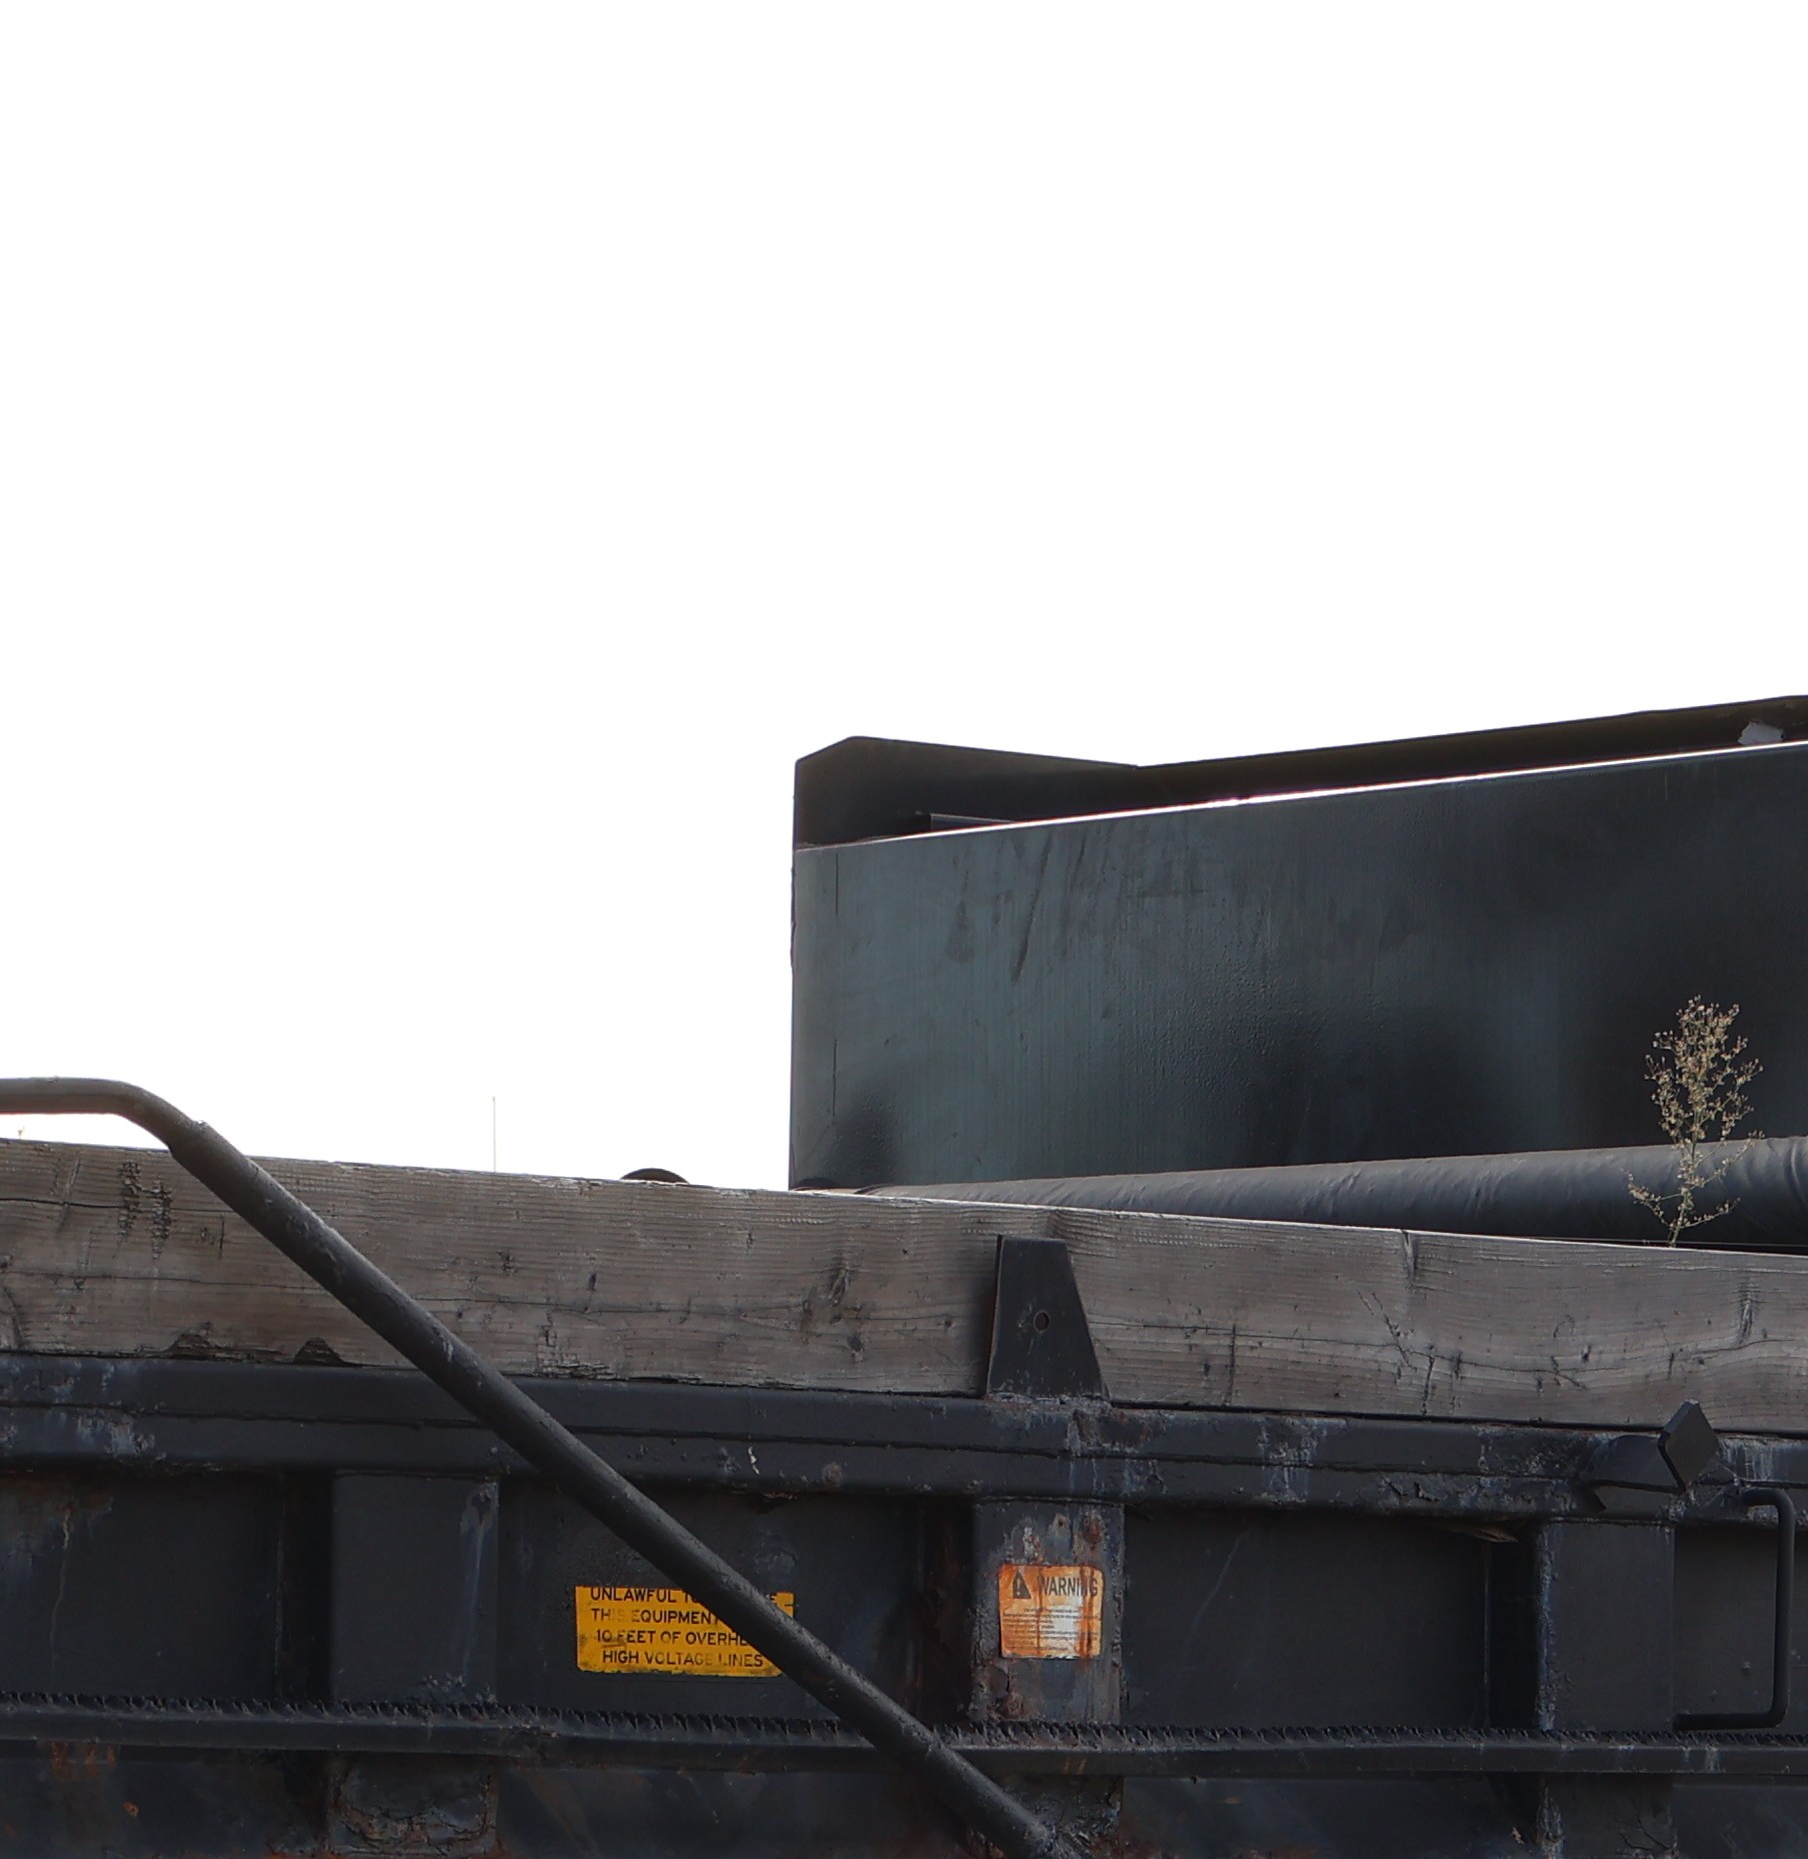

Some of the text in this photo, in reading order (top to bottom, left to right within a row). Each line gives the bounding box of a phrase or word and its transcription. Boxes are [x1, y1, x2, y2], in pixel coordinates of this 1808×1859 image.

[591, 1587, 677, 1603] UNLAWFUL
[592, 1608, 626, 1622] THIS
[596, 1629, 612, 1643] 10
[617, 1630, 657, 1644] FEET
[660, 1631, 679, 1645] OF
[602, 1650, 764, 1668] HIGH VOLTAGE LINES
